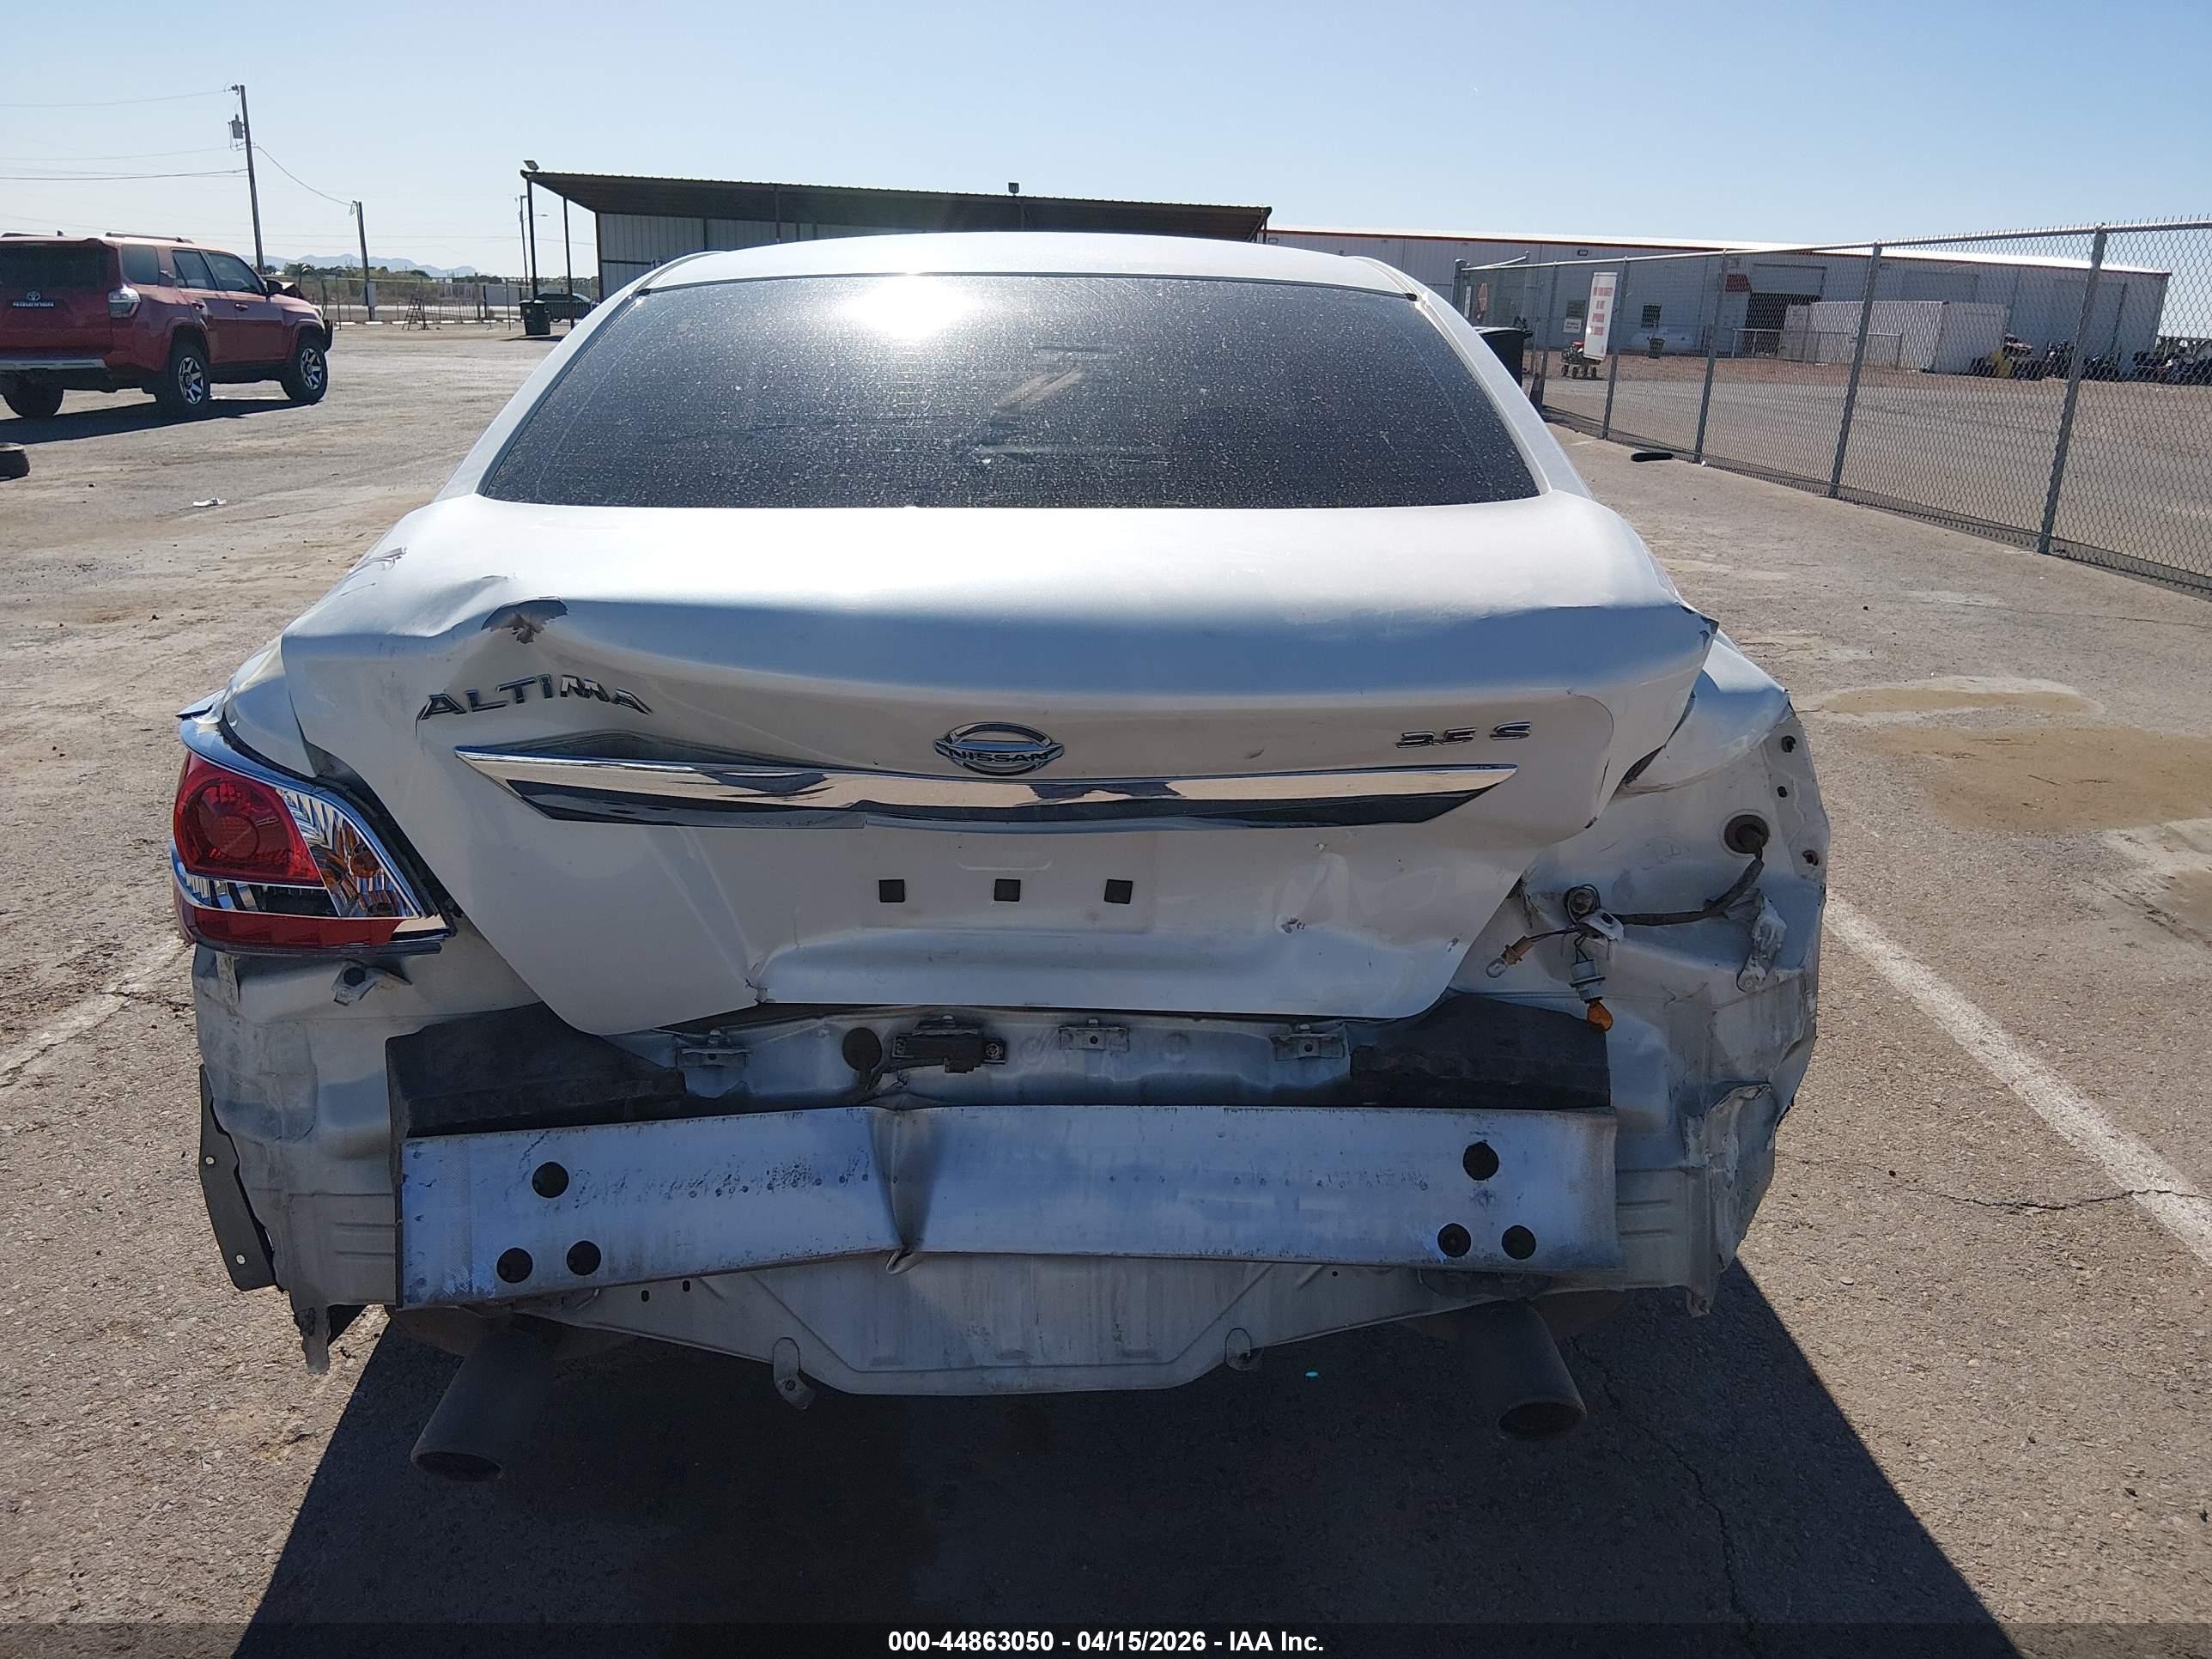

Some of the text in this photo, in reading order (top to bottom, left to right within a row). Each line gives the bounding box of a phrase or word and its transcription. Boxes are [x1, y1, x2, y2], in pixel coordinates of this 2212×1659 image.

[418, 673, 653, 720] ALTIMA
[1395, 721, 1532, 749] 3.5 S
[948, 747, 1051, 763] NISSAN
